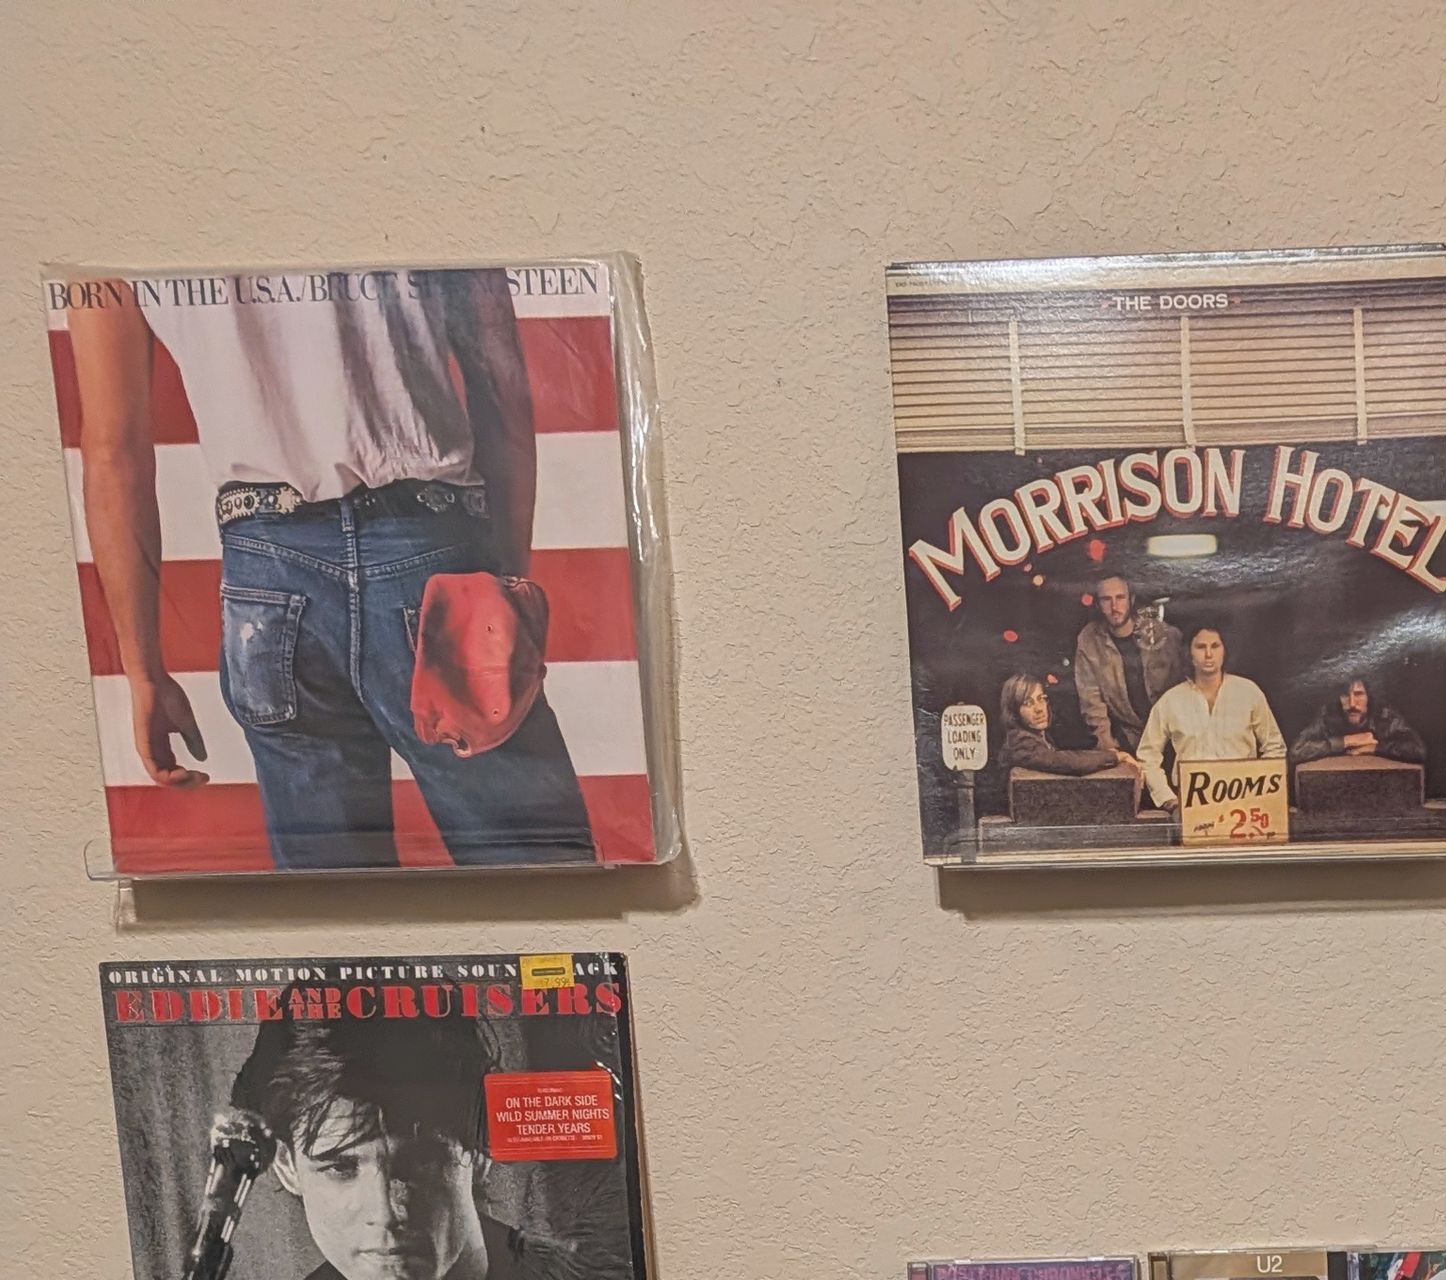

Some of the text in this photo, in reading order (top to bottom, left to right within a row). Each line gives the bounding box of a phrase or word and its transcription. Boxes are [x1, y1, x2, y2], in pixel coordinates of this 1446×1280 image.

[49, 277, 127, 311] BORN
[131, 279, 163, 309] IN
[165, 276, 229, 309] THE
[1113, 293, 1229, 312] THE DOORS
[907, 447, 1246, 611] MORRISON
[944, 712, 985, 727] PASSENGER
[947, 730, 981, 744] LOADING
[953, 747, 976, 760] ONLY
[108, 961, 618, 985] ORIGINAL MOTION PICTURE SOUNACK
[113, 986, 284, 1023] EDDIE
[288, 986, 342, 1004] AND
[345, 981, 622, 1019] CRUISERS
[289, 1002, 342, 1021] THE
[505, 1094, 598, 1109] ON THE DARK SIDE
[496, 1108, 610, 1122] WILD SUMMER NIGHTS
[516, 1122, 591, 1135] TENDER YEARS
[1256, 1254, 1283, 1274] U2
